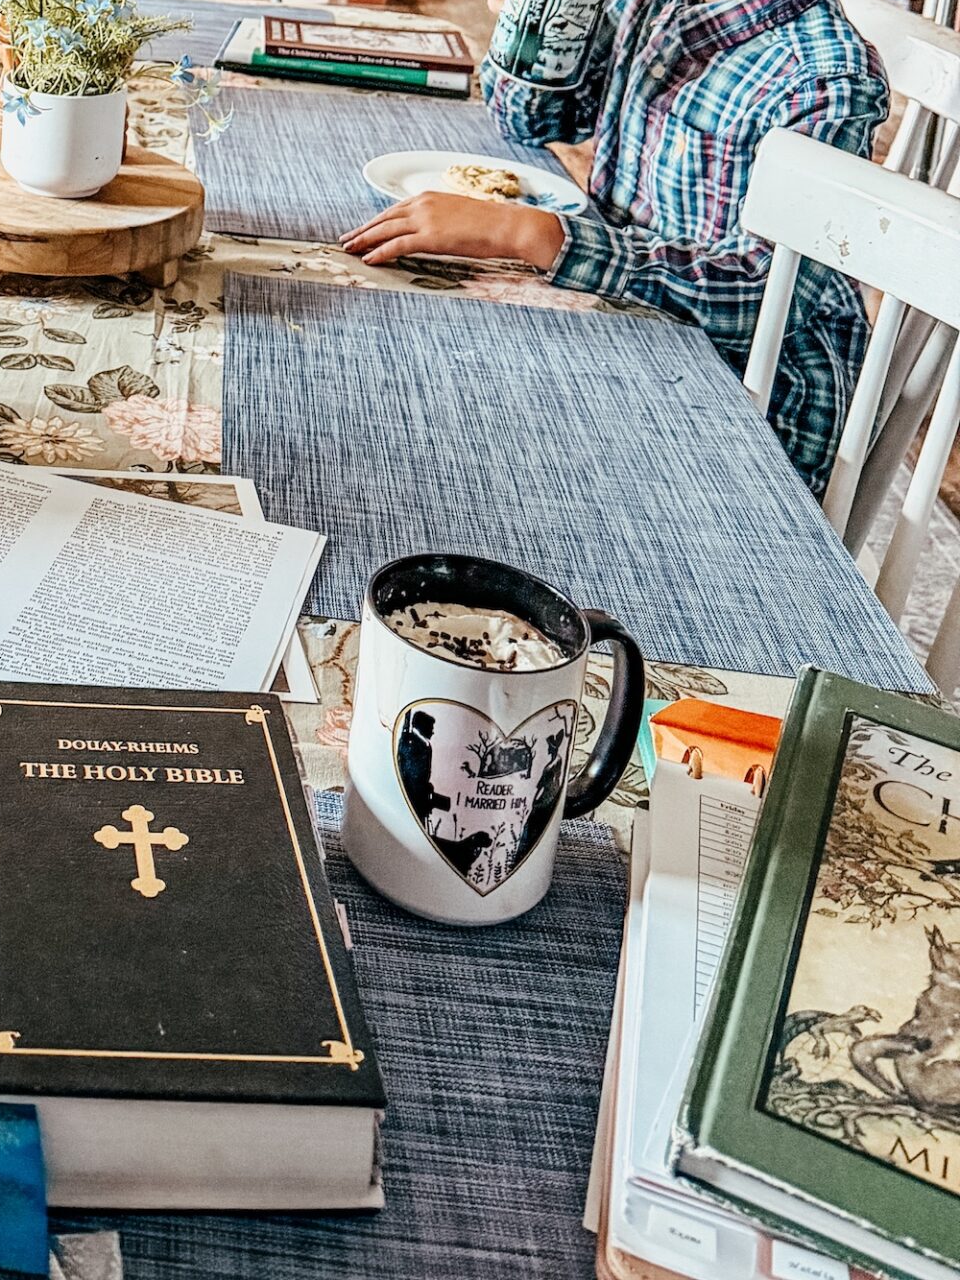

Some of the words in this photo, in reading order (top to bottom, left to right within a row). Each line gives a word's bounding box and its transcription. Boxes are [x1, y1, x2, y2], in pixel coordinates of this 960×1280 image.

[57, 738, 200, 755] DOUAY-RHEIMS
[19, 761, 78, 780] THE
[82, 763, 159, 783] HOLY
[164, 767, 245, 786] BIBLE
[888, 746, 953, 782] The
[464, 795, 507, 810] MARRIED
